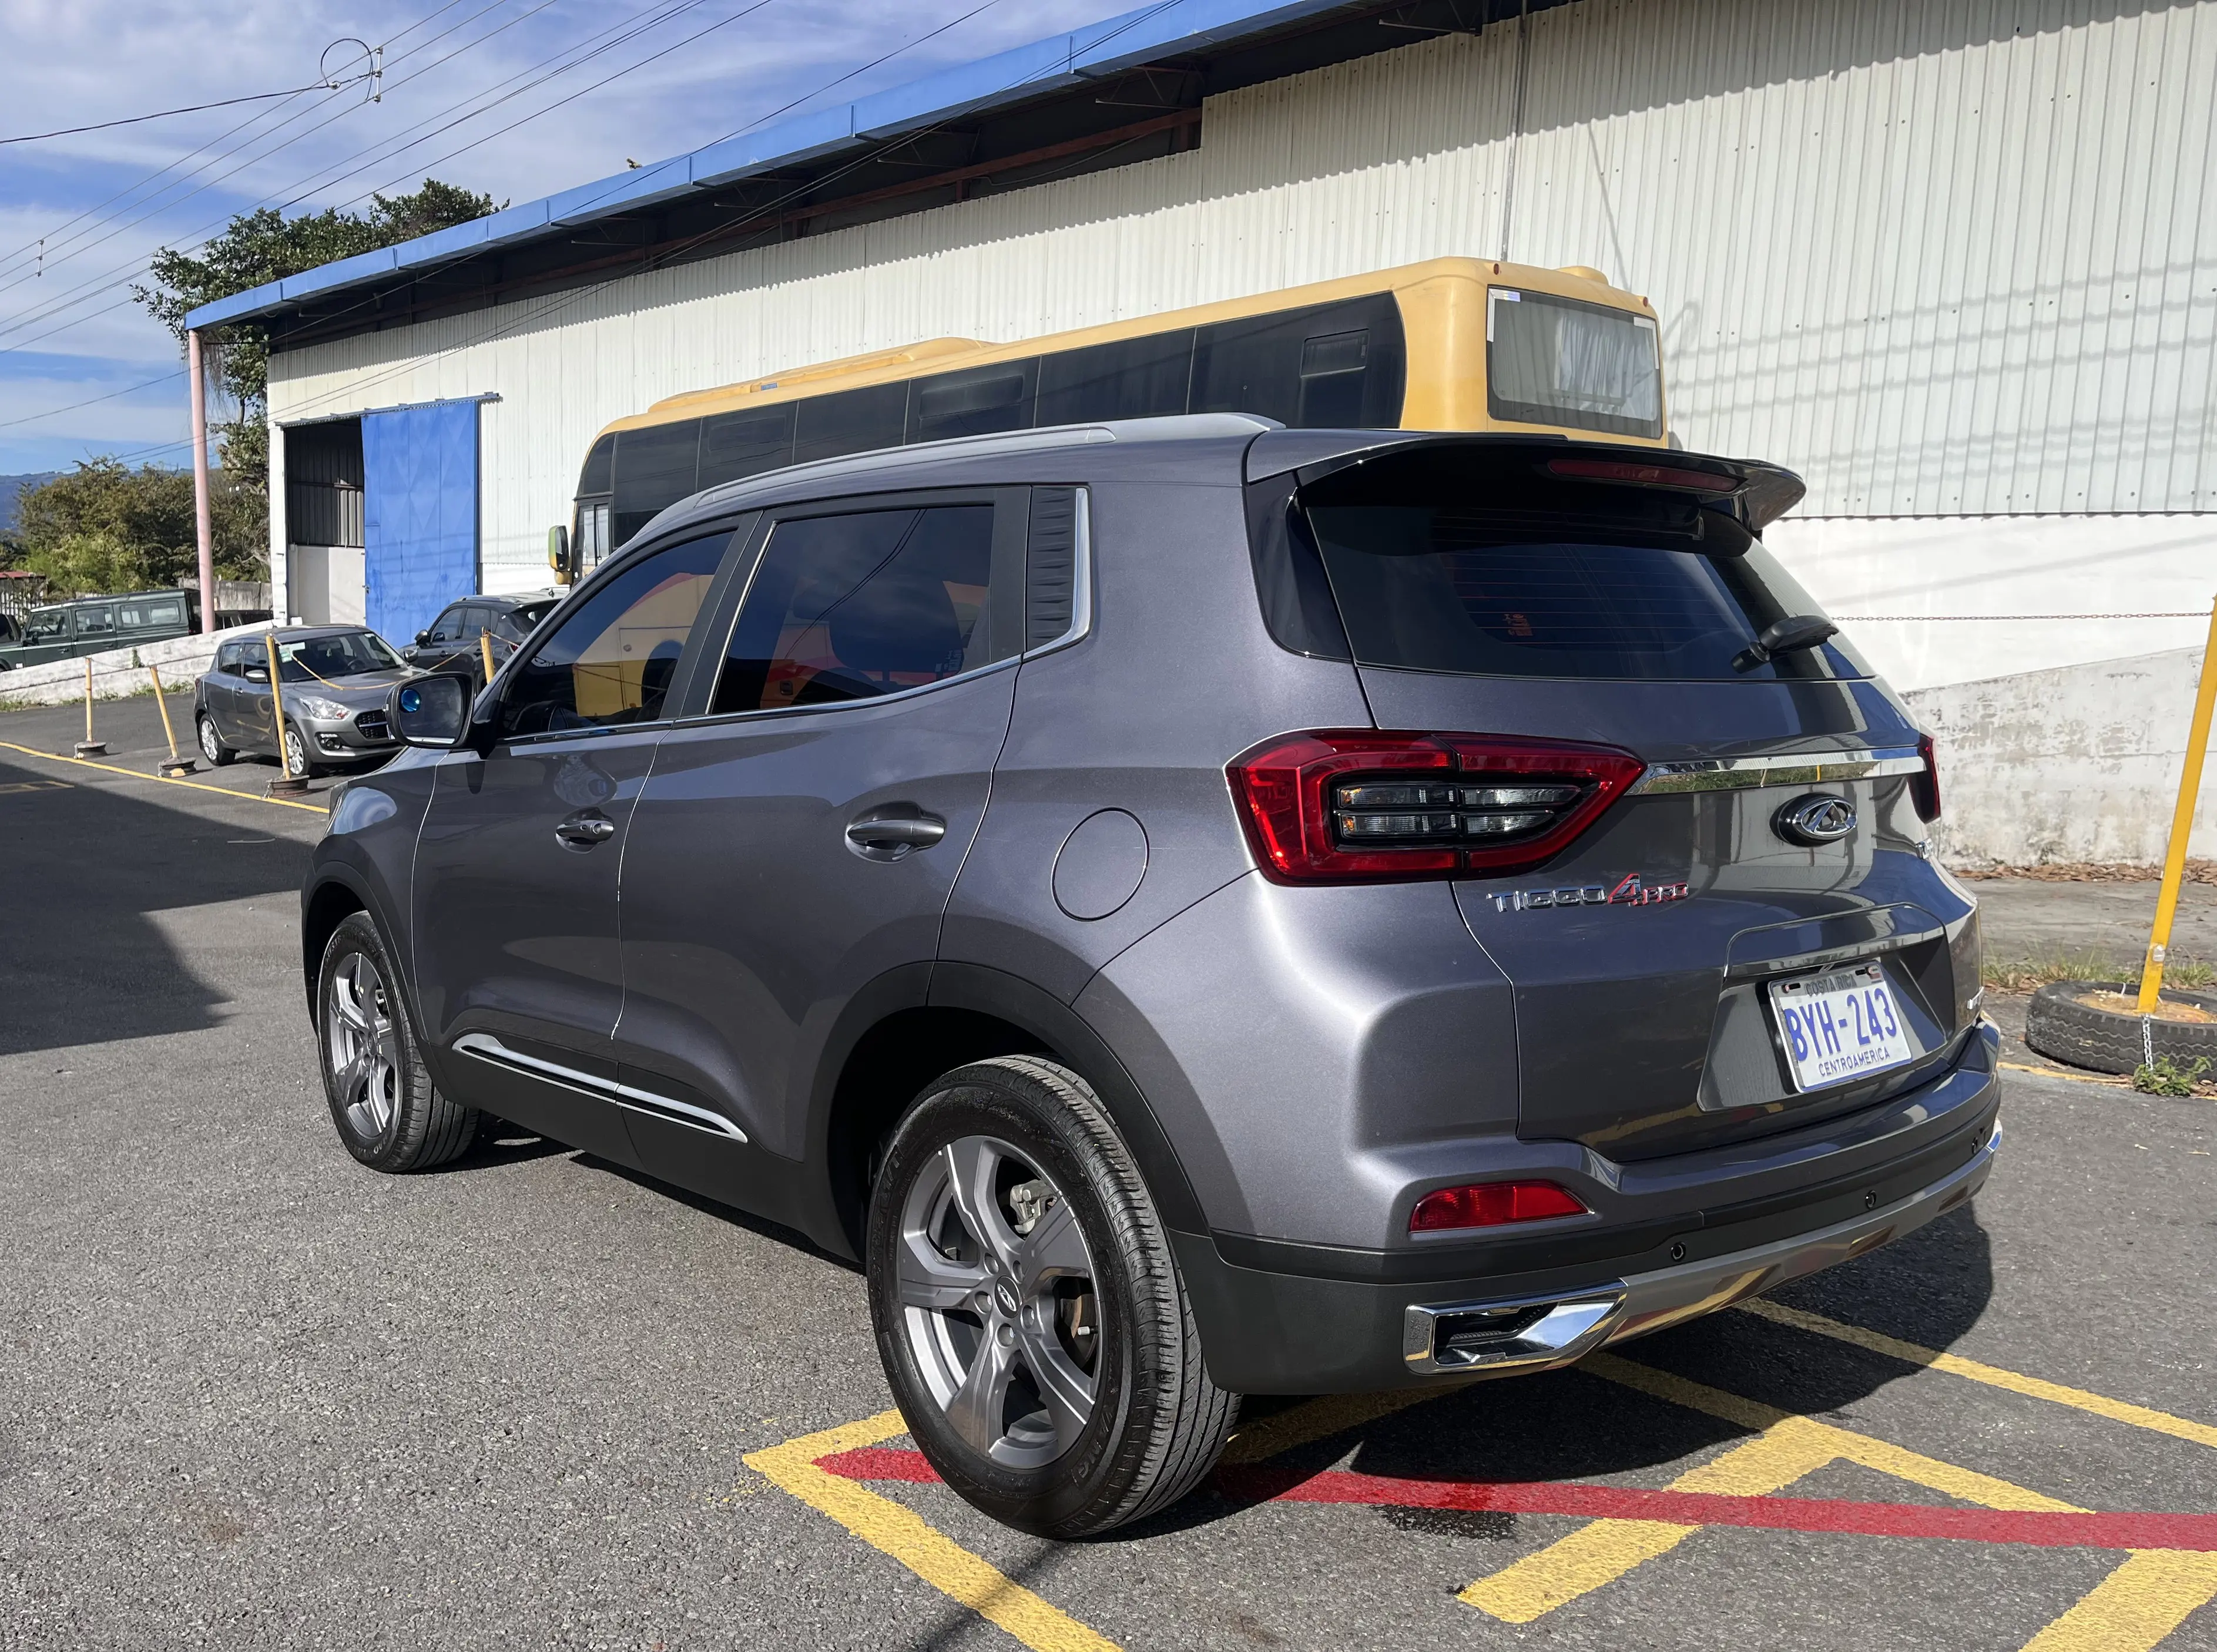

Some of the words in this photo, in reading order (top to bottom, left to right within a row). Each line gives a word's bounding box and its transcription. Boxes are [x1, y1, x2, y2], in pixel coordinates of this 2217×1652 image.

[1485, 884, 1608, 912] TIGGO
[1805, 977, 1836, 997] COSTA
[1834, 973, 1857, 990] RICA
[1784, 988, 1897, 1062] BYH-243
[1819, 1048, 1890, 1077] CENTROAMERICA
